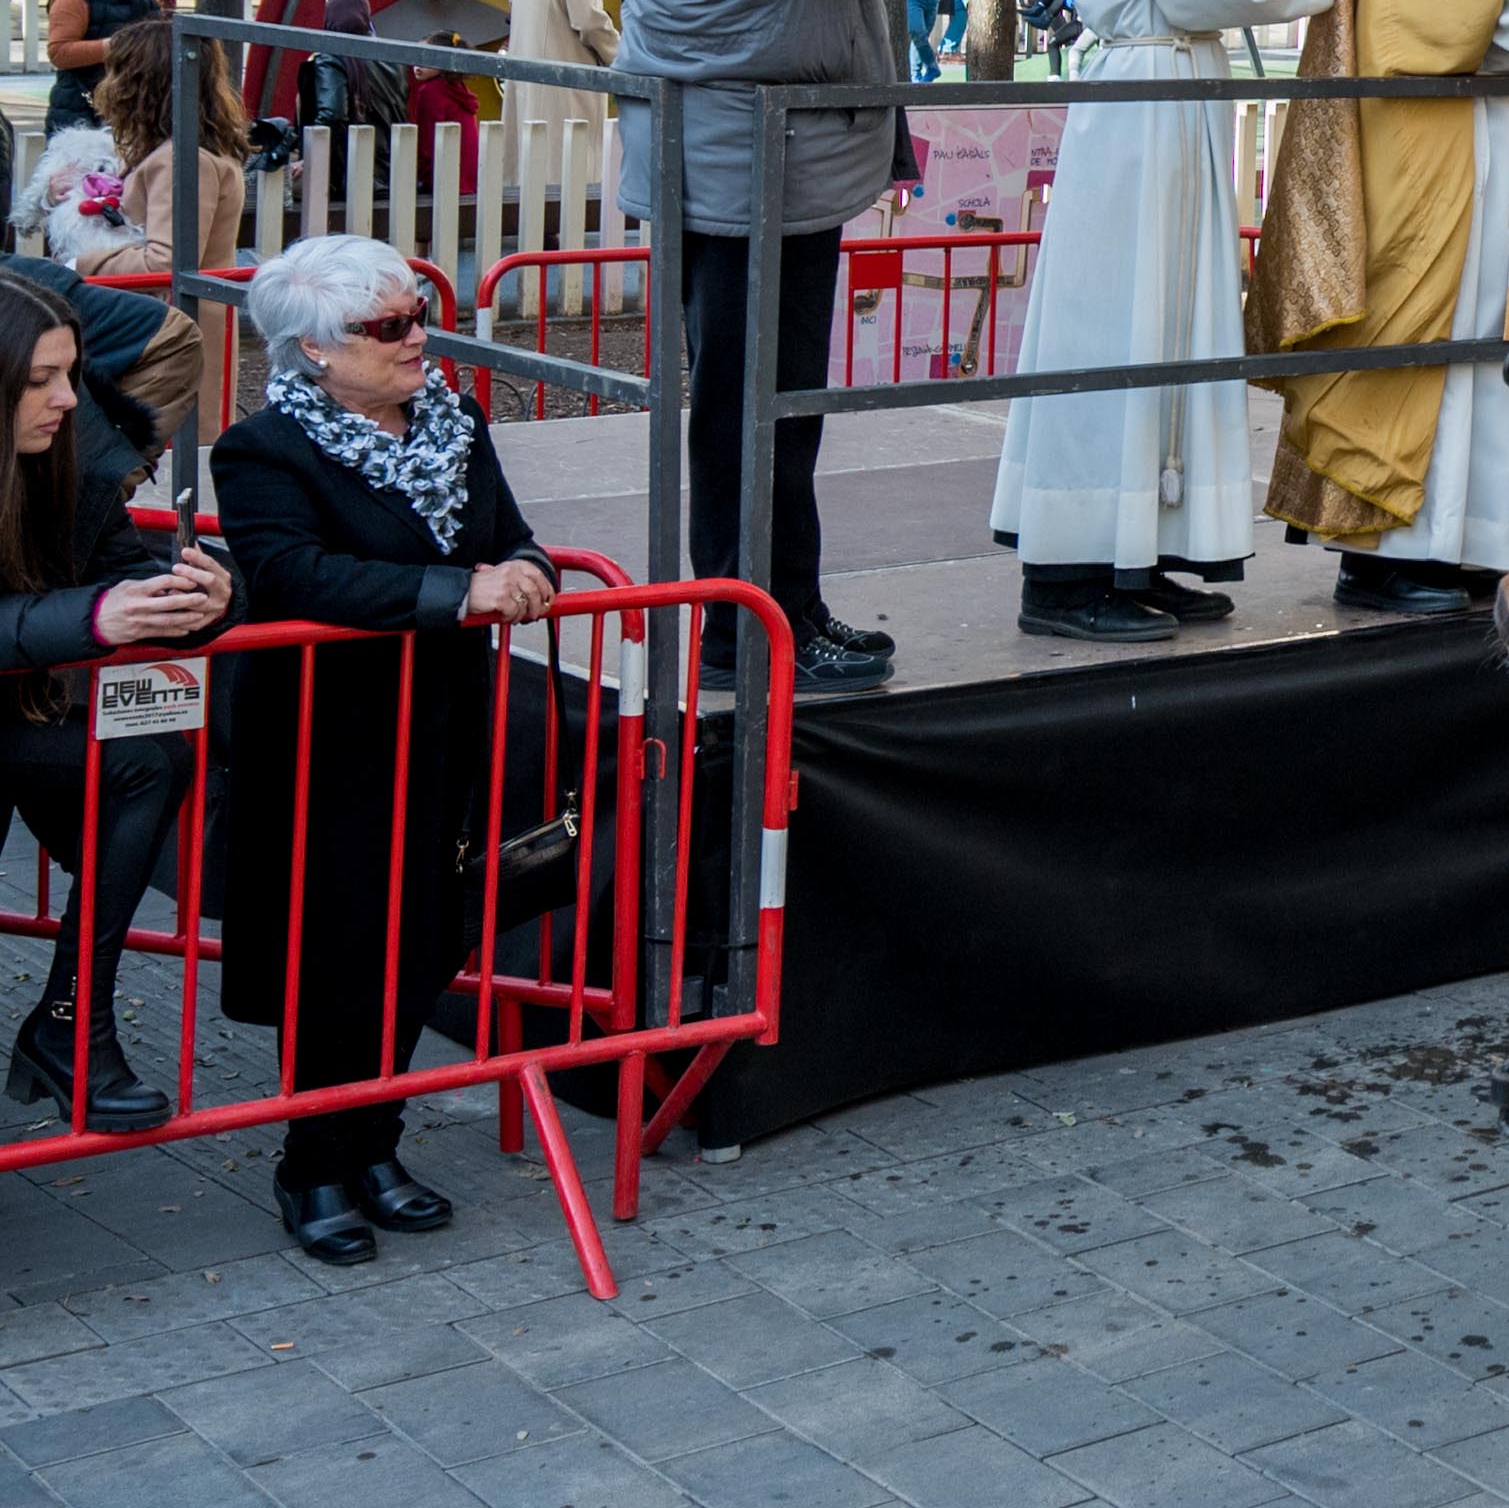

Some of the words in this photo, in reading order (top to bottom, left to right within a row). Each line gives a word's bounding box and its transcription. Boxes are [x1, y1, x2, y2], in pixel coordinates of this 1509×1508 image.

[933, 149, 953, 160] PAU
[102, 678, 152, 699] NEW
[102, 687, 200, 709] EVENTS
